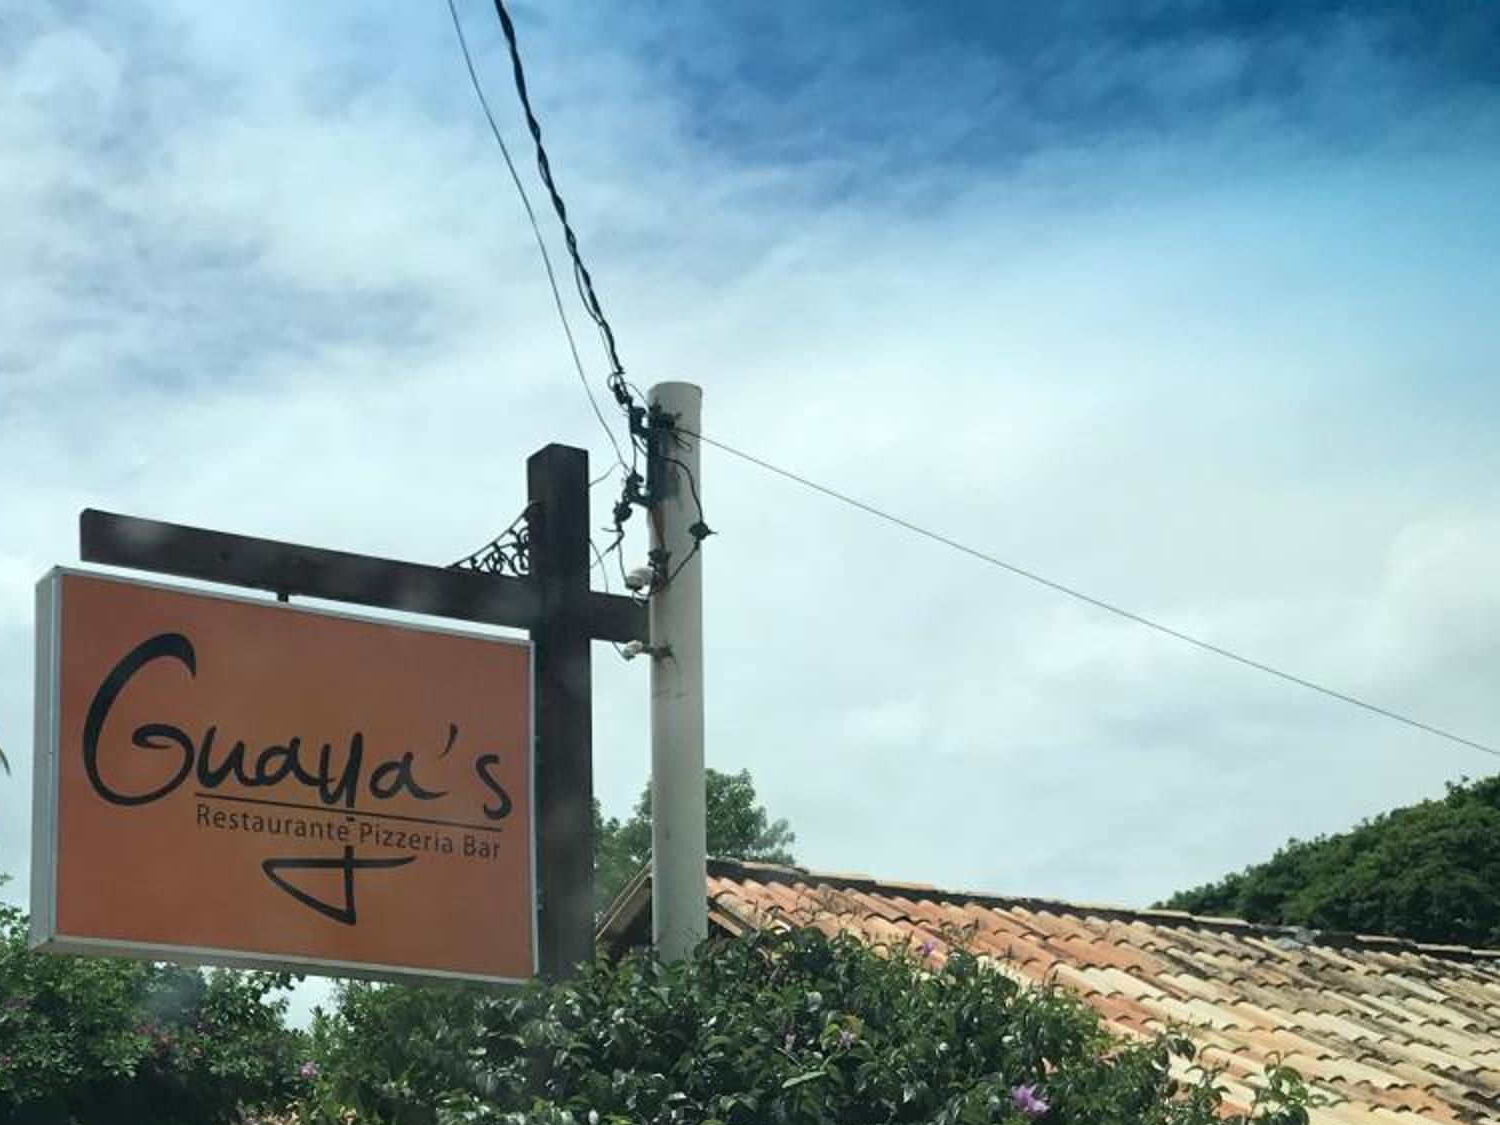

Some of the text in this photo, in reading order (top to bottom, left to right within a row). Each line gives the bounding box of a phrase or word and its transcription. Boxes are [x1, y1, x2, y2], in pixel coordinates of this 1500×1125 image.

[83, 632, 512, 926] Guaya's
[196, 803, 501, 860] Restaurante Pizzeria Bar
